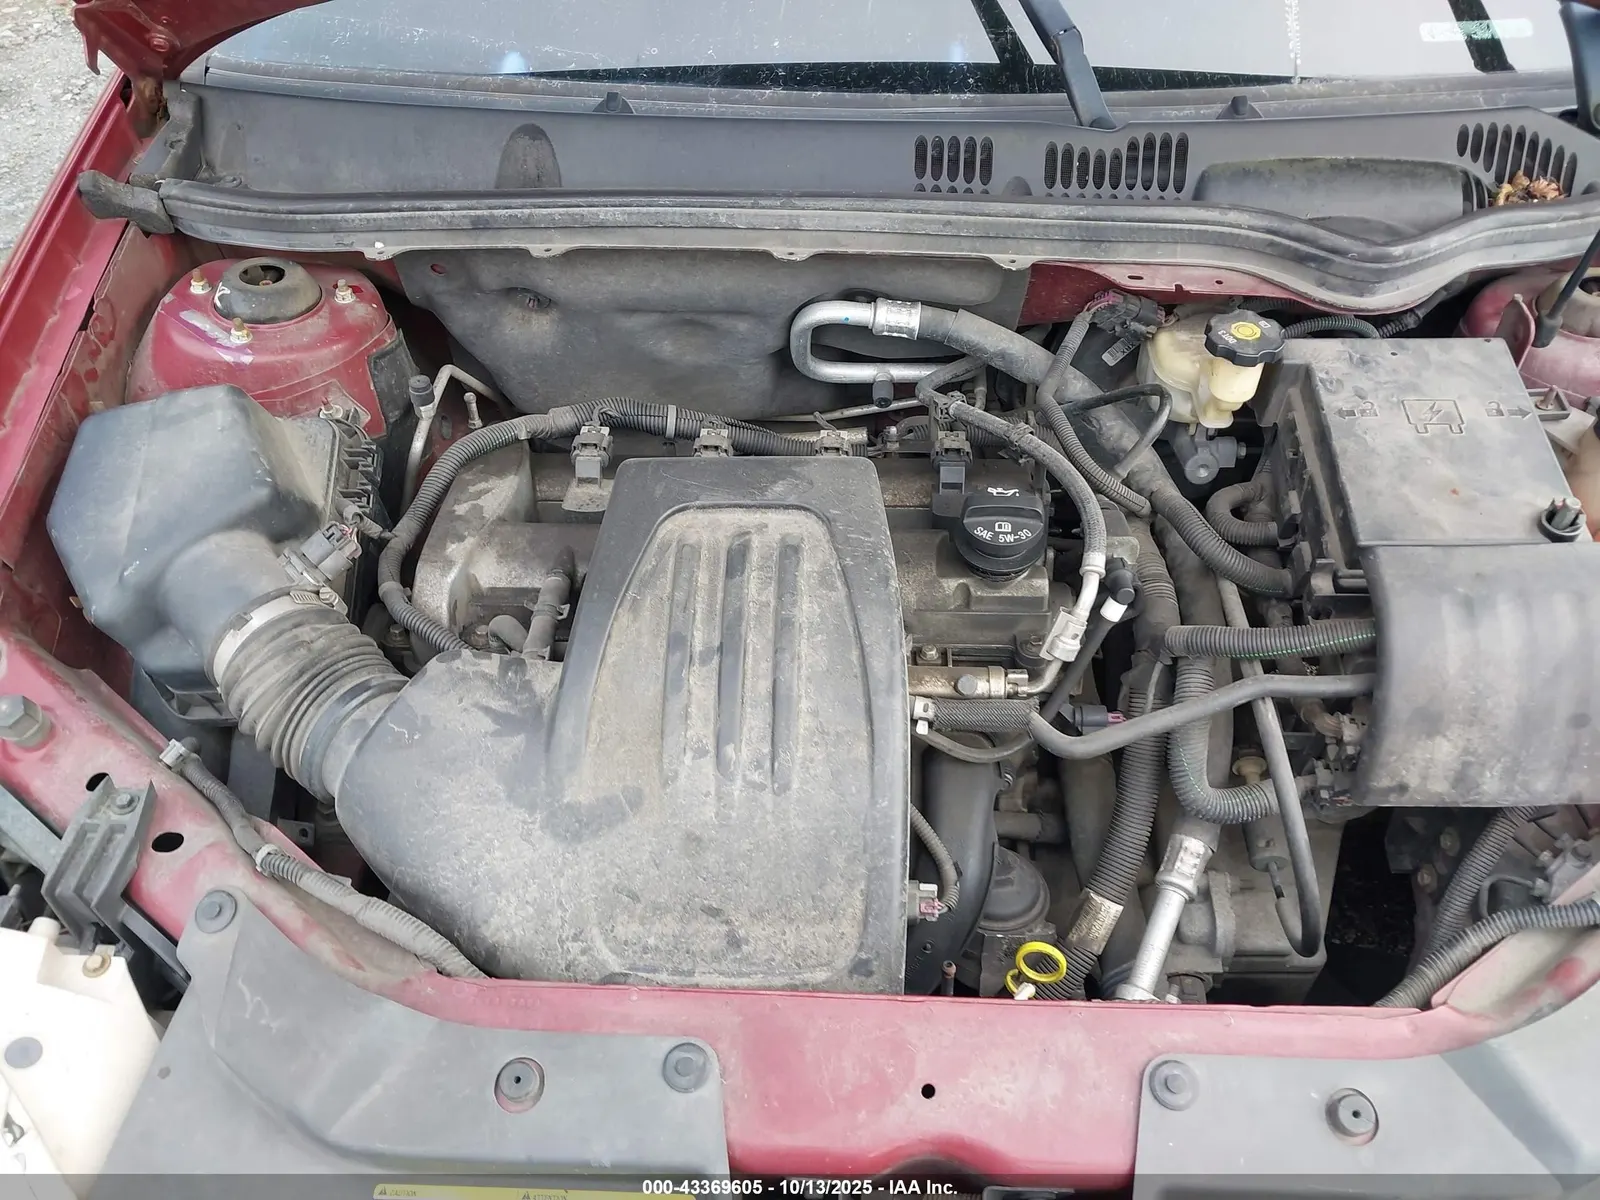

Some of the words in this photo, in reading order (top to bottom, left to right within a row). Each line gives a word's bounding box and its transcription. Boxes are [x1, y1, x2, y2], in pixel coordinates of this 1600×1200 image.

[1222, 333, 1237, 344] DOT
[973, 526, 994, 540] SAE
[998, 529, 1032, 543] 5W-30
